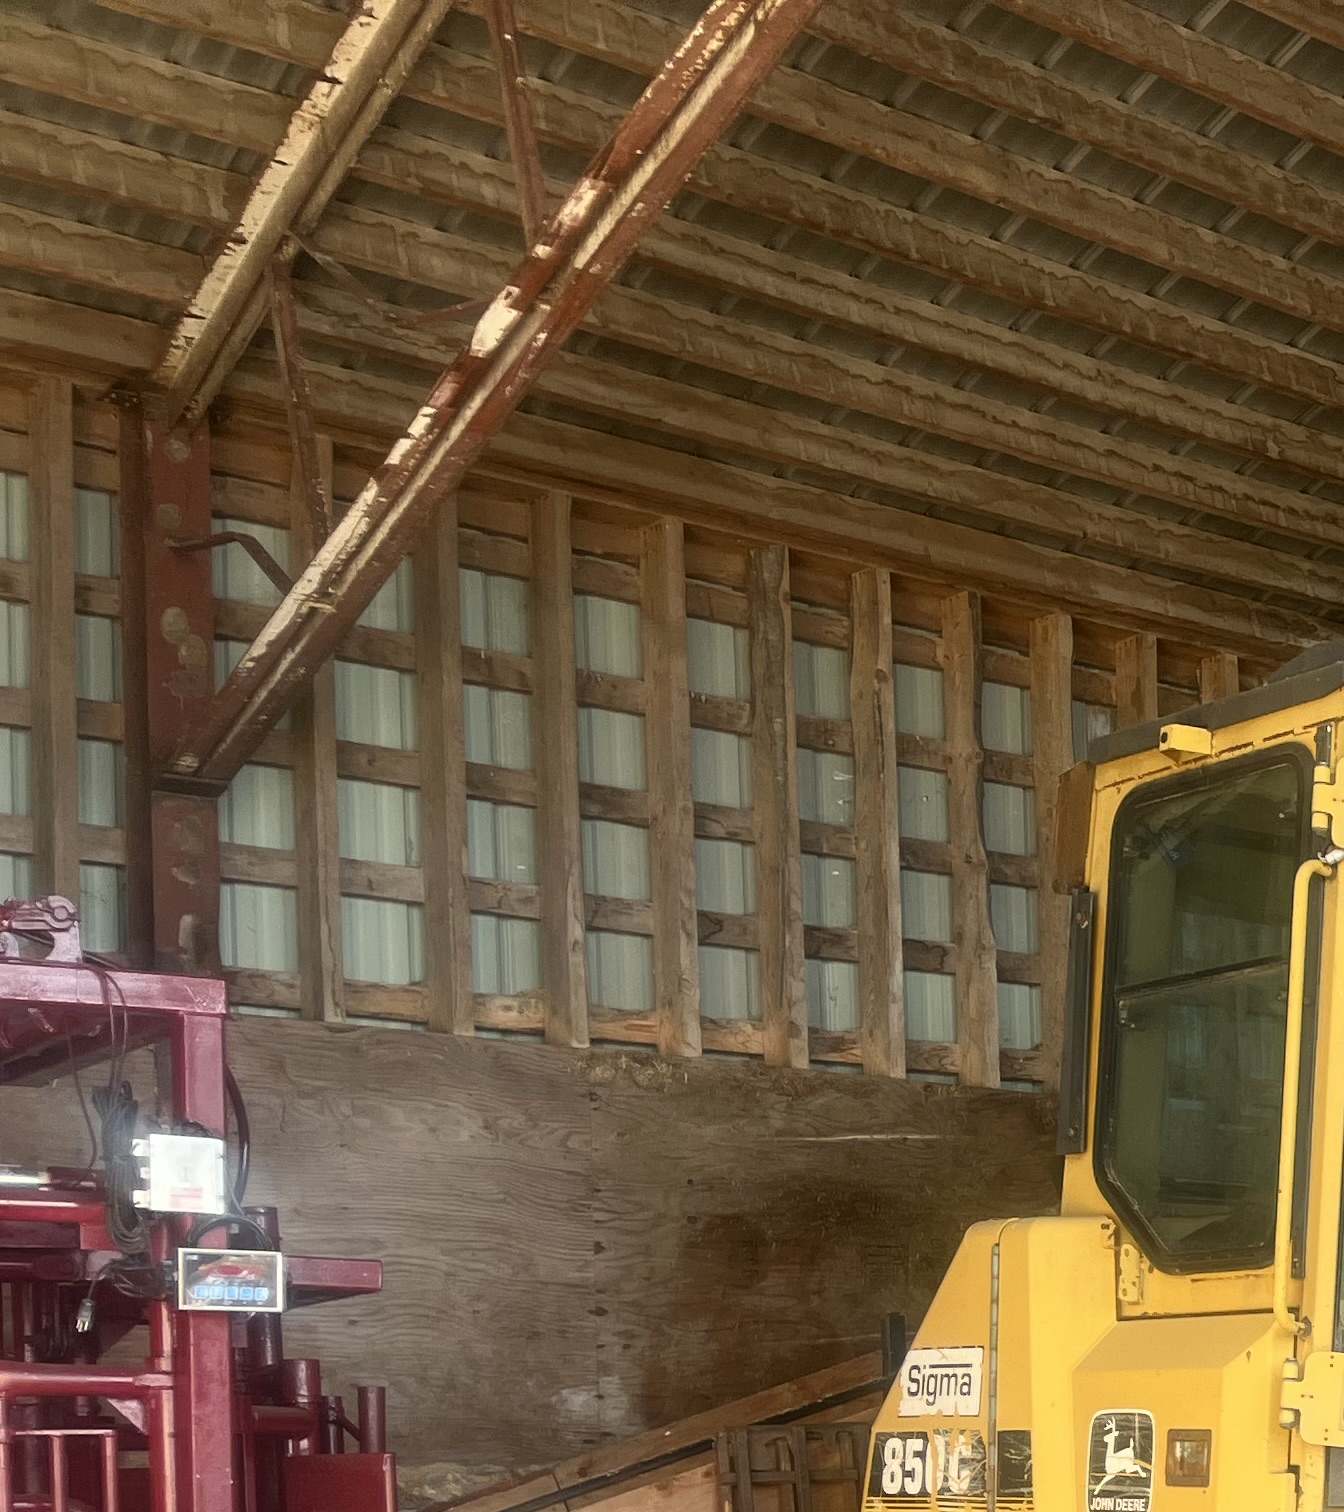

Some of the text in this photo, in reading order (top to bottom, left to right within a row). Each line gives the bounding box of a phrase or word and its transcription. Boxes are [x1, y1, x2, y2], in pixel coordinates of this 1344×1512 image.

[907, 1364, 973, 1406] Sigma
[1090, 1497, 1146, 1512] JOHN DEERE
